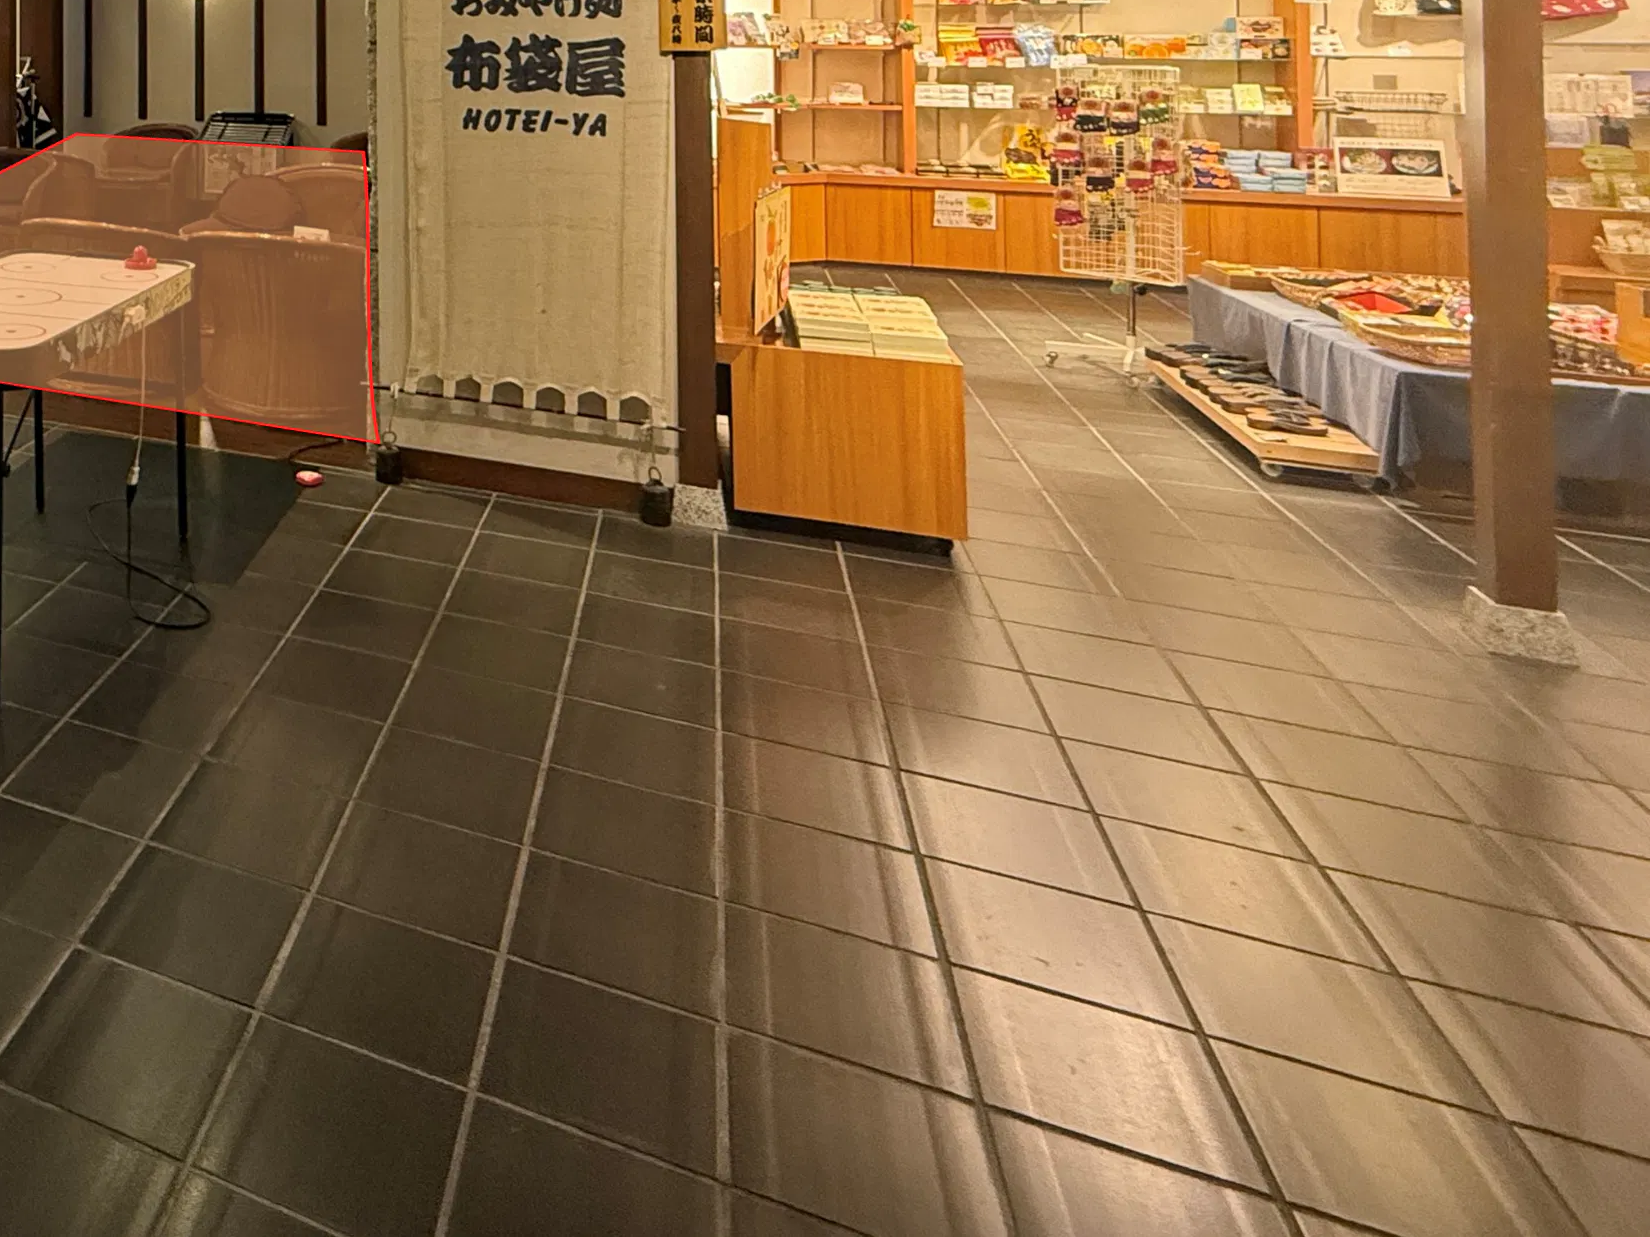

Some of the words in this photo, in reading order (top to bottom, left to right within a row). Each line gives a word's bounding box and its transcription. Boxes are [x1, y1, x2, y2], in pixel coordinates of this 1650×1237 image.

[444, 33, 626, 97] 布袋屋
[462, 108, 608, 137] HOTEI-YA
